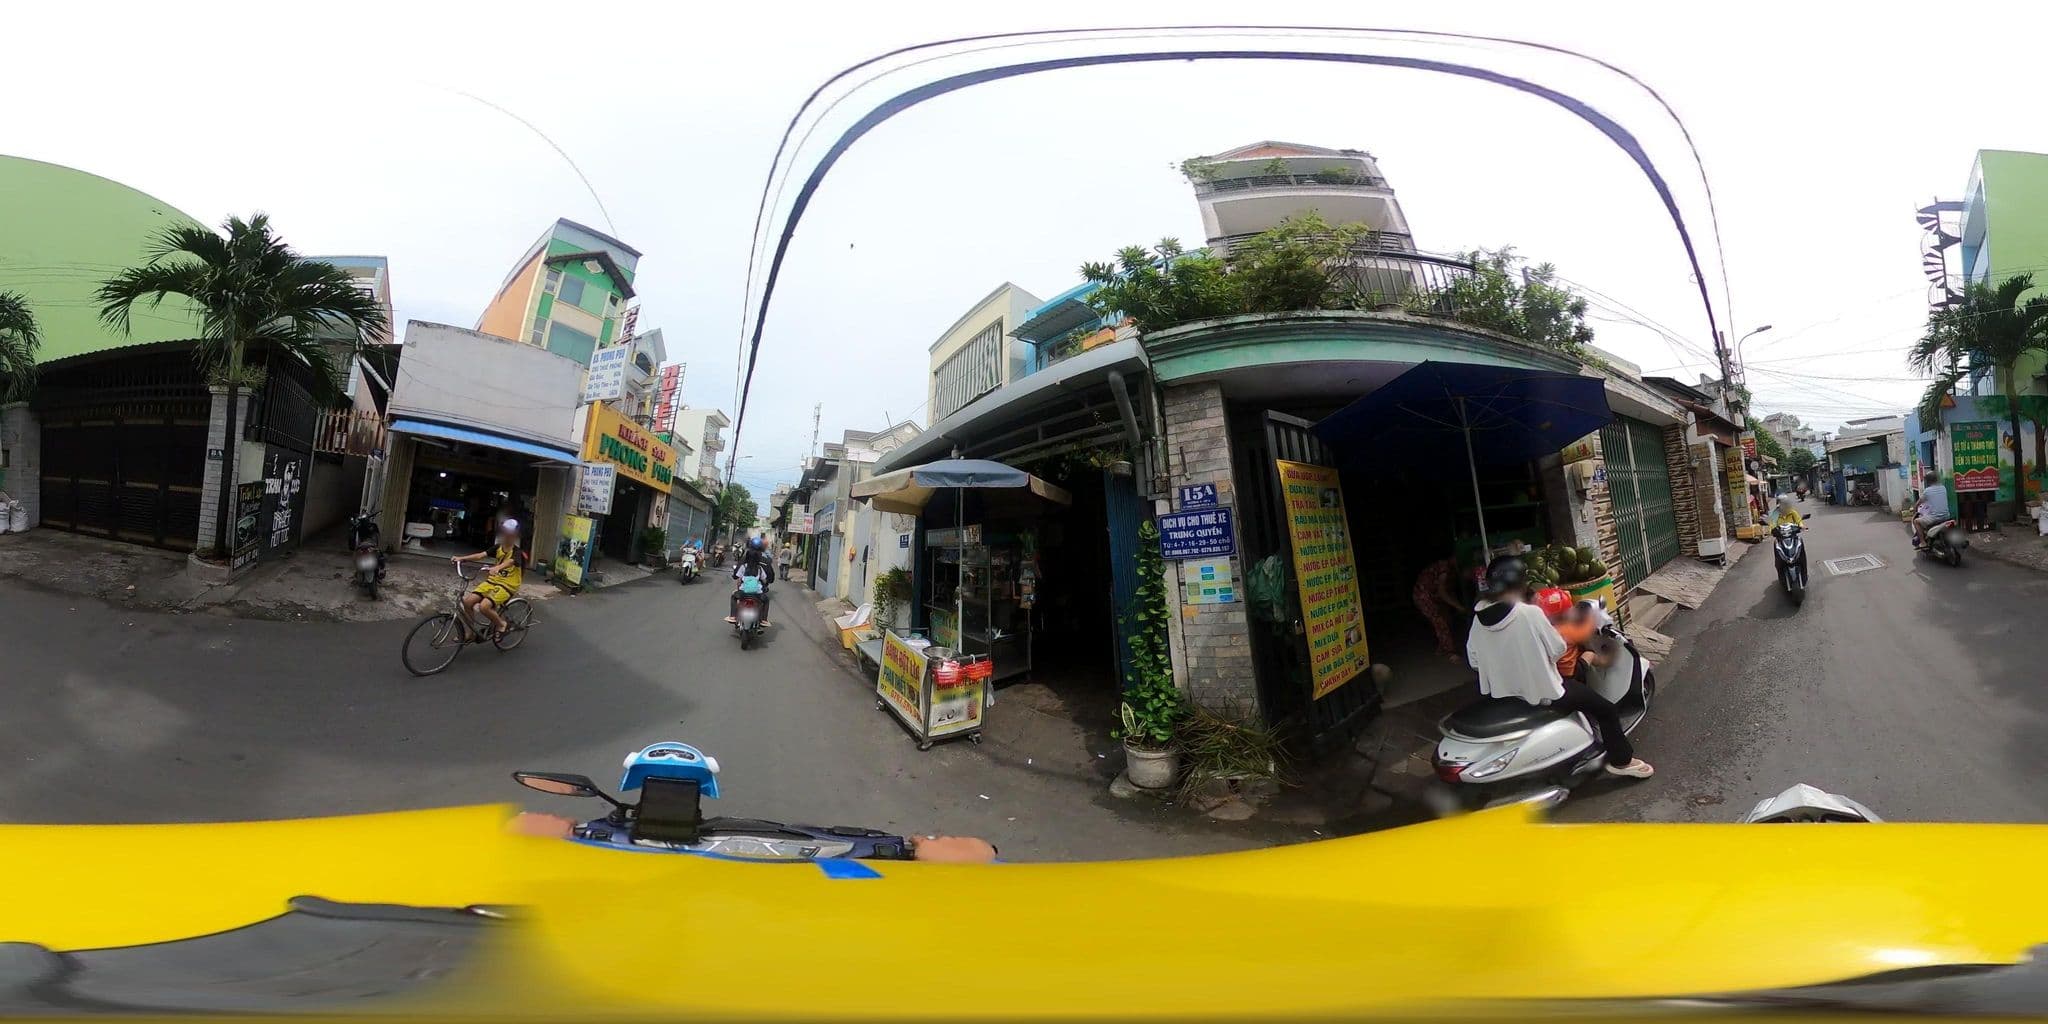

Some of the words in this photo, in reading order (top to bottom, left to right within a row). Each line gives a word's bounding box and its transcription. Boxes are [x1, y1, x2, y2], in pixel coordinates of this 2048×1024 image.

[654, 364, 680, 432] HOTEL
[618, 423, 648, 451] KHÁCH
[599, 433, 647, 473] PHONG
[651, 462, 672, 485] PHÚ
[1184, 485, 1213, 502] 15A
[1162, 517, 1177, 531] DỊCH
[1177, 516, 1186, 530] VỤ
[1187, 515, 1200, 527] CHO
[1200, 511, 1217, 525] THUÊ
[1218, 512, 1227, 524] XE
[1168, 529, 1195, 540] TRUNG
[1316, 653, 1330, 664] CAM
